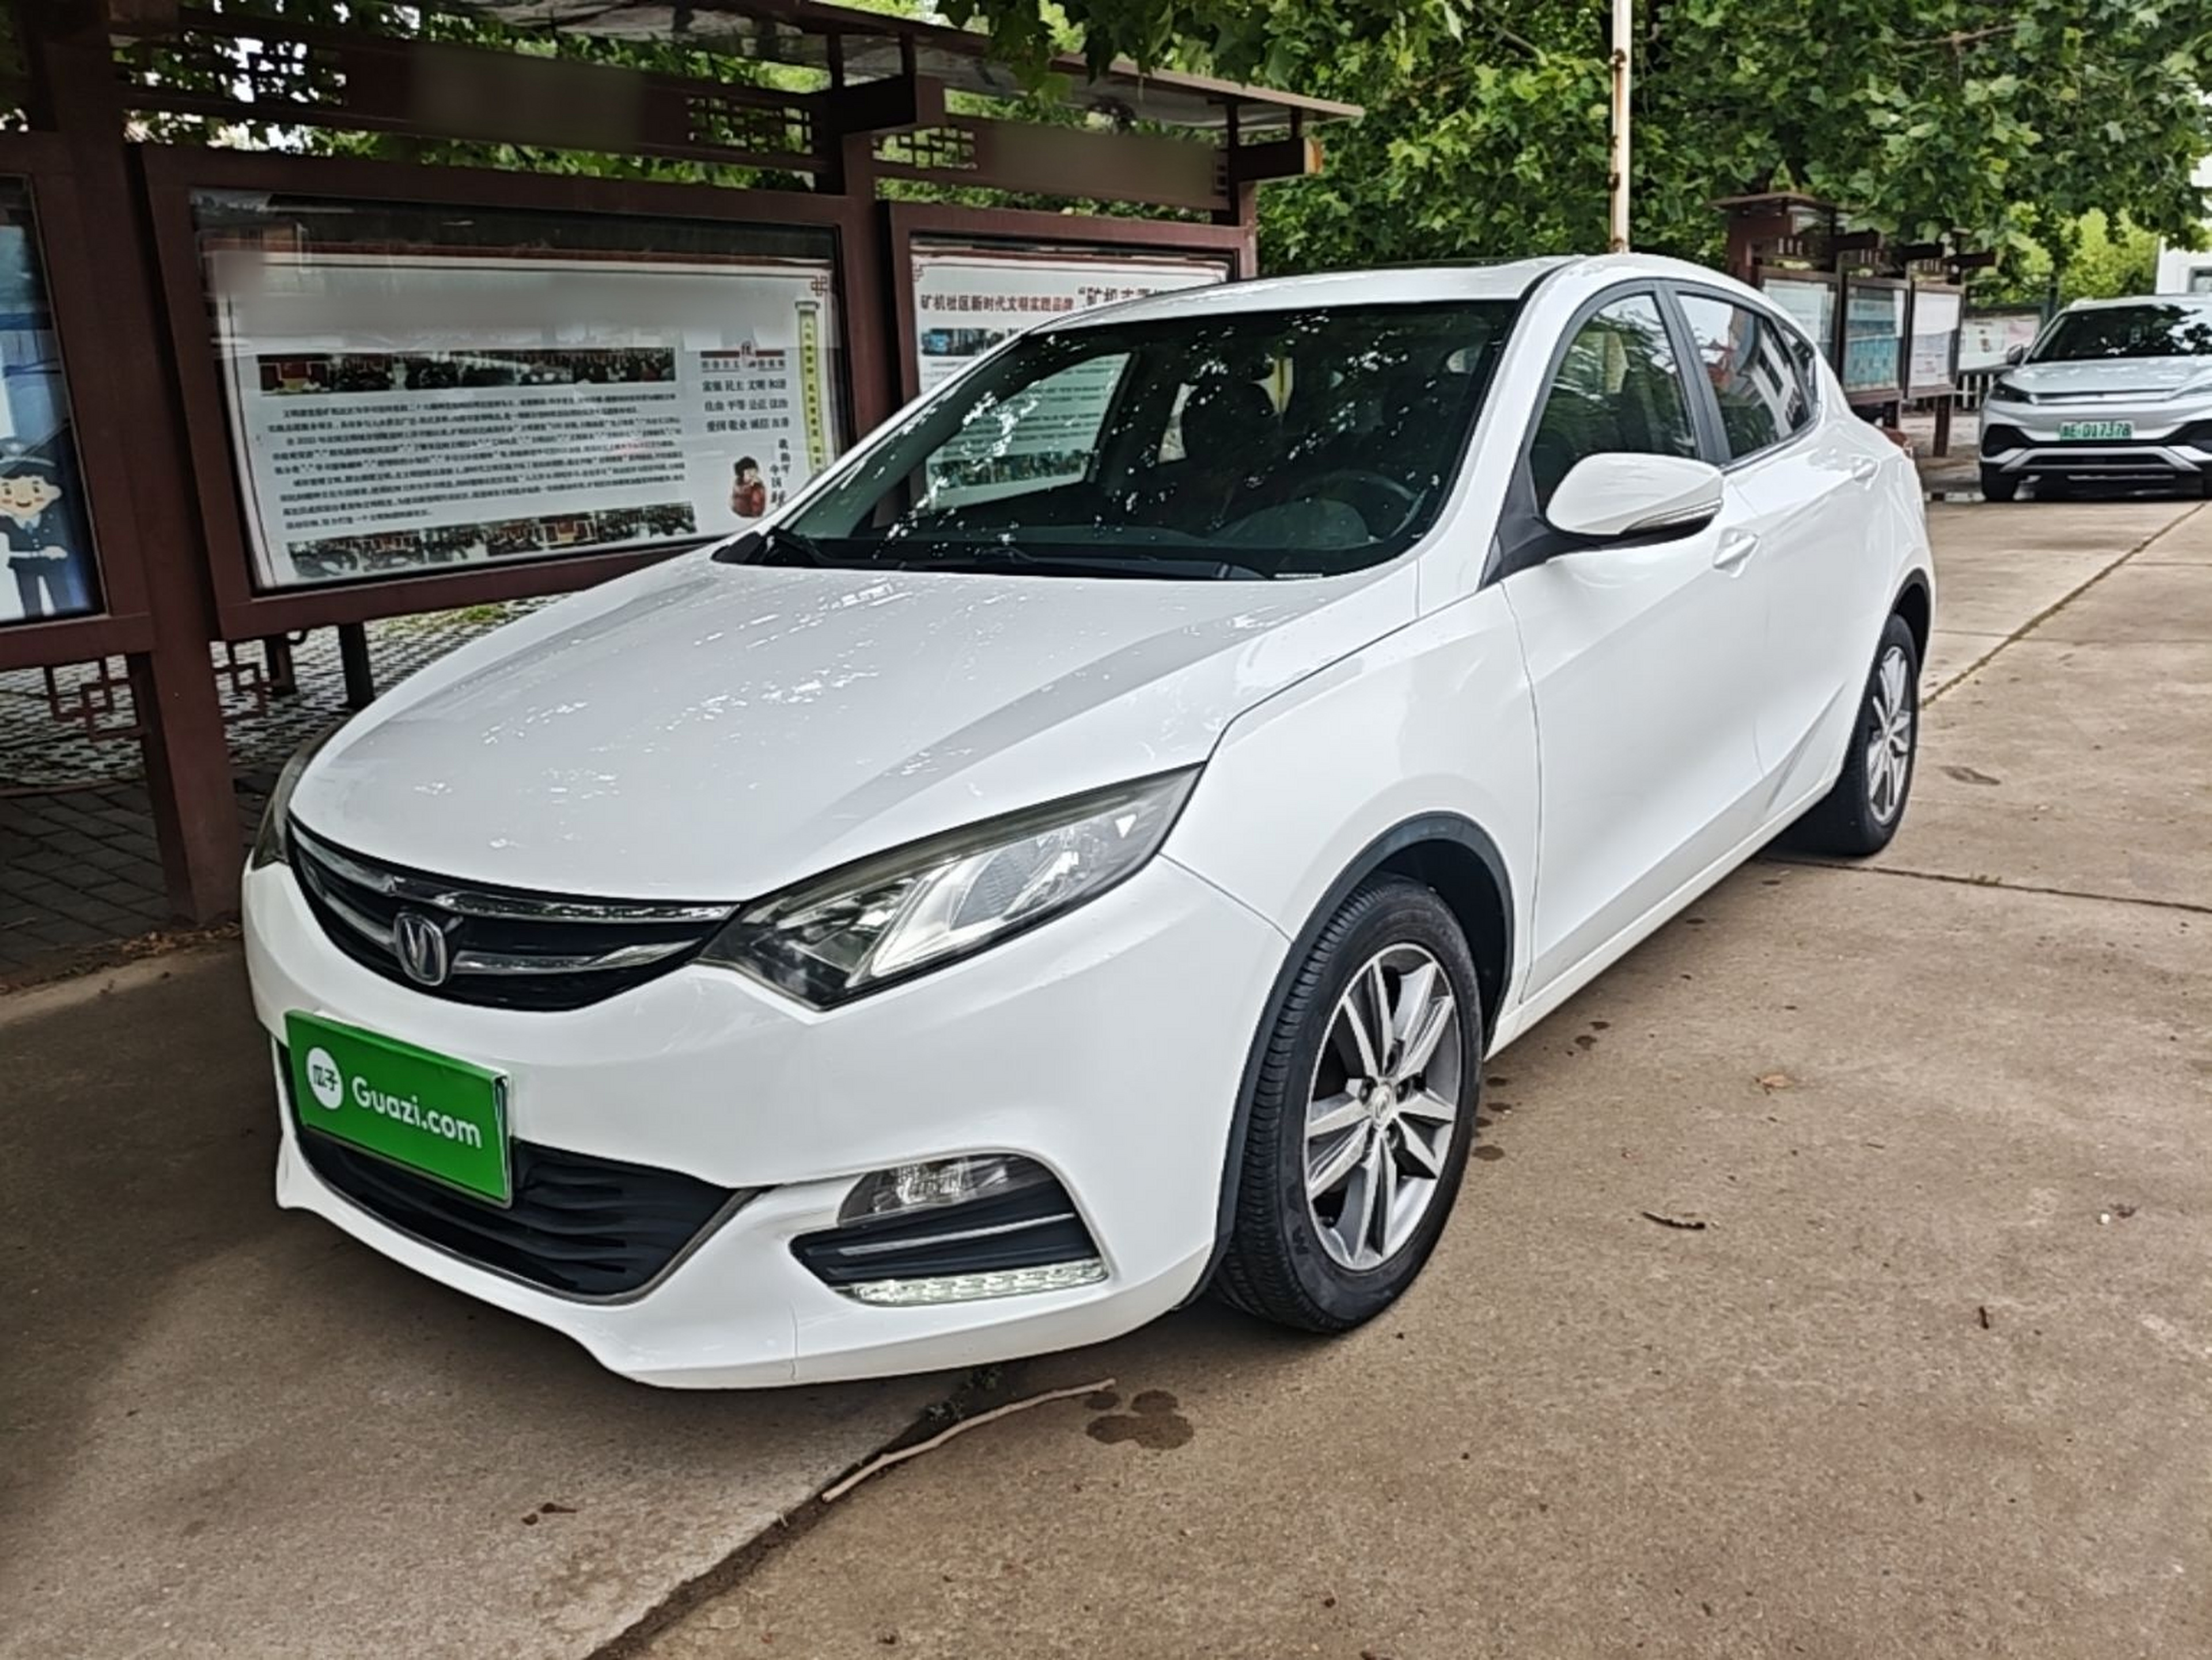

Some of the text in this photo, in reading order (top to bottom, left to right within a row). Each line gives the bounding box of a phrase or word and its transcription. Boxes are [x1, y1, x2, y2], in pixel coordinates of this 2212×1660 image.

[921, 294, 1074, 312] 矿机社区新时代文明实践品牌
[312, 1064, 338, 1092] 瓜子
[352, 1076, 482, 1149] Guazi.com
